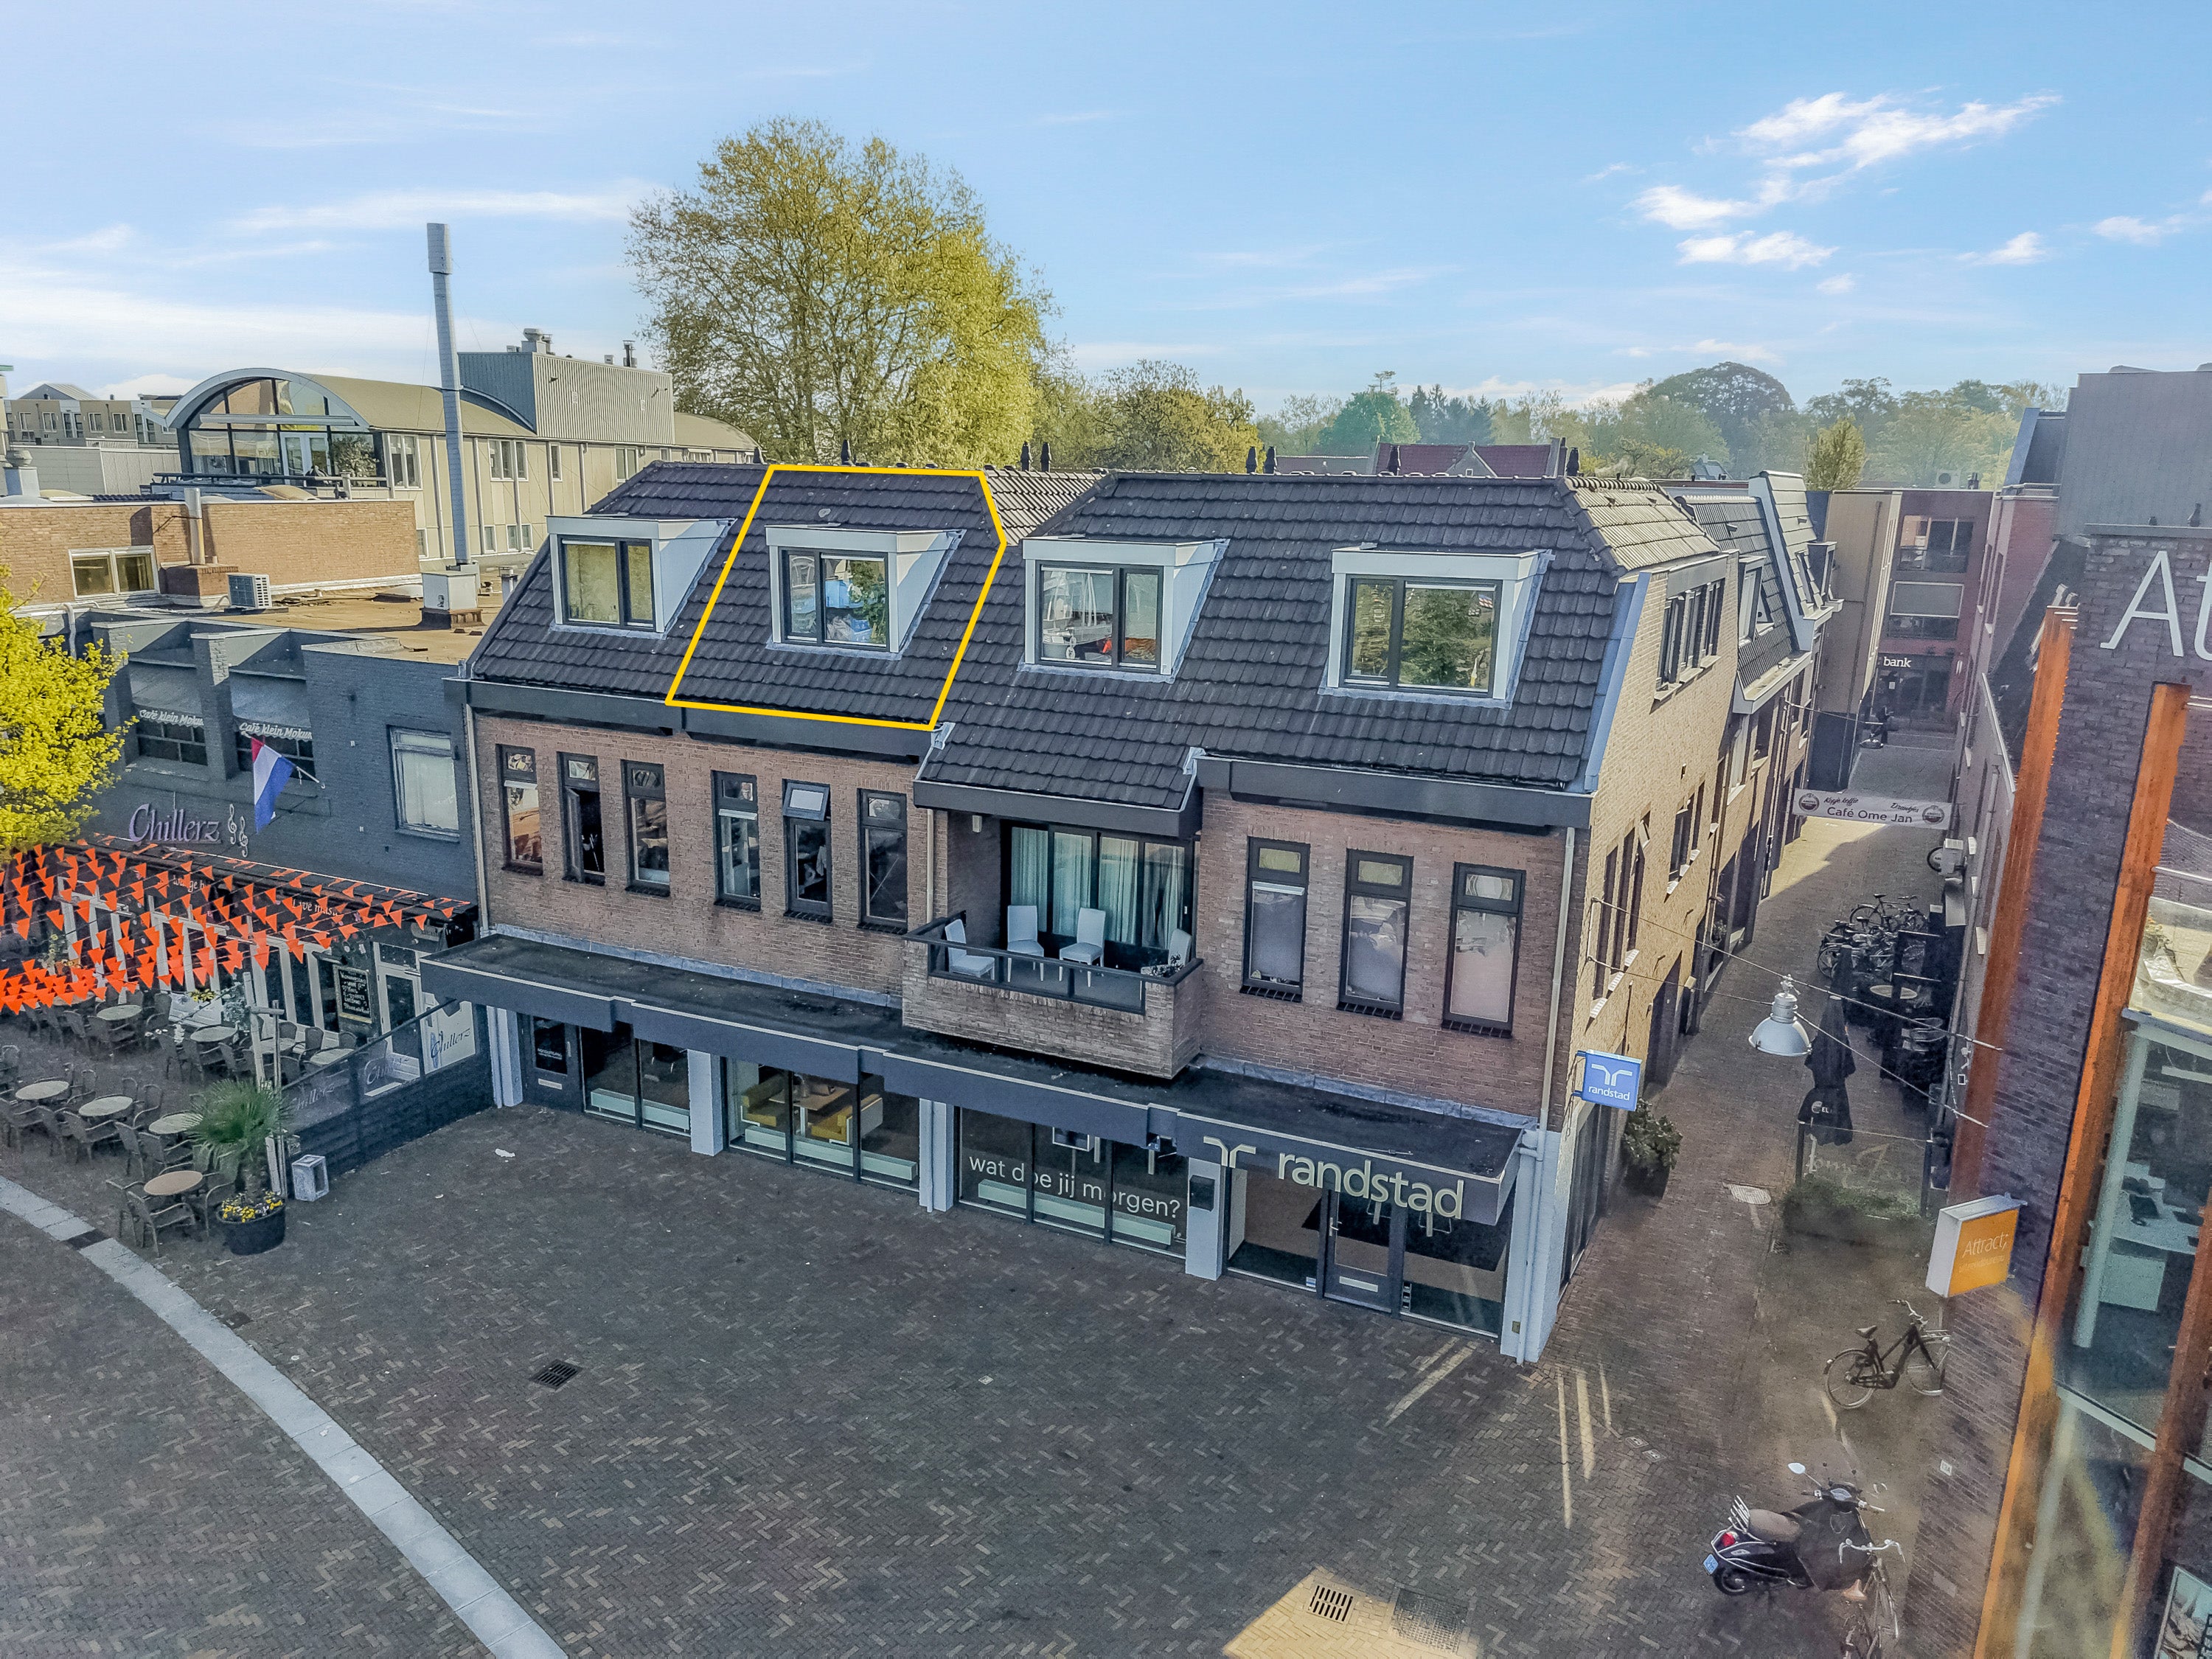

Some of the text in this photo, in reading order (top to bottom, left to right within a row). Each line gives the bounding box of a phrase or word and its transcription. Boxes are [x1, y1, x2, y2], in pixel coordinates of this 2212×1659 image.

[1883, 656, 1911, 668] bank
[139, 709, 158, 720] Café
[179, 714, 204, 726] Moku
[239, 722, 260, 734] Café
[262, 723, 283, 736] klein
[128, 803, 220, 842] Chillerz
[1827, 807, 1913, 823] Café Ome Jan
[1588, 1085, 1631, 1101] randstad
[970, 1156, 1005, 1178] wat
[1058, 1172, 1075, 1198] jij
[1278, 1152, 1464, 1220] randstad
